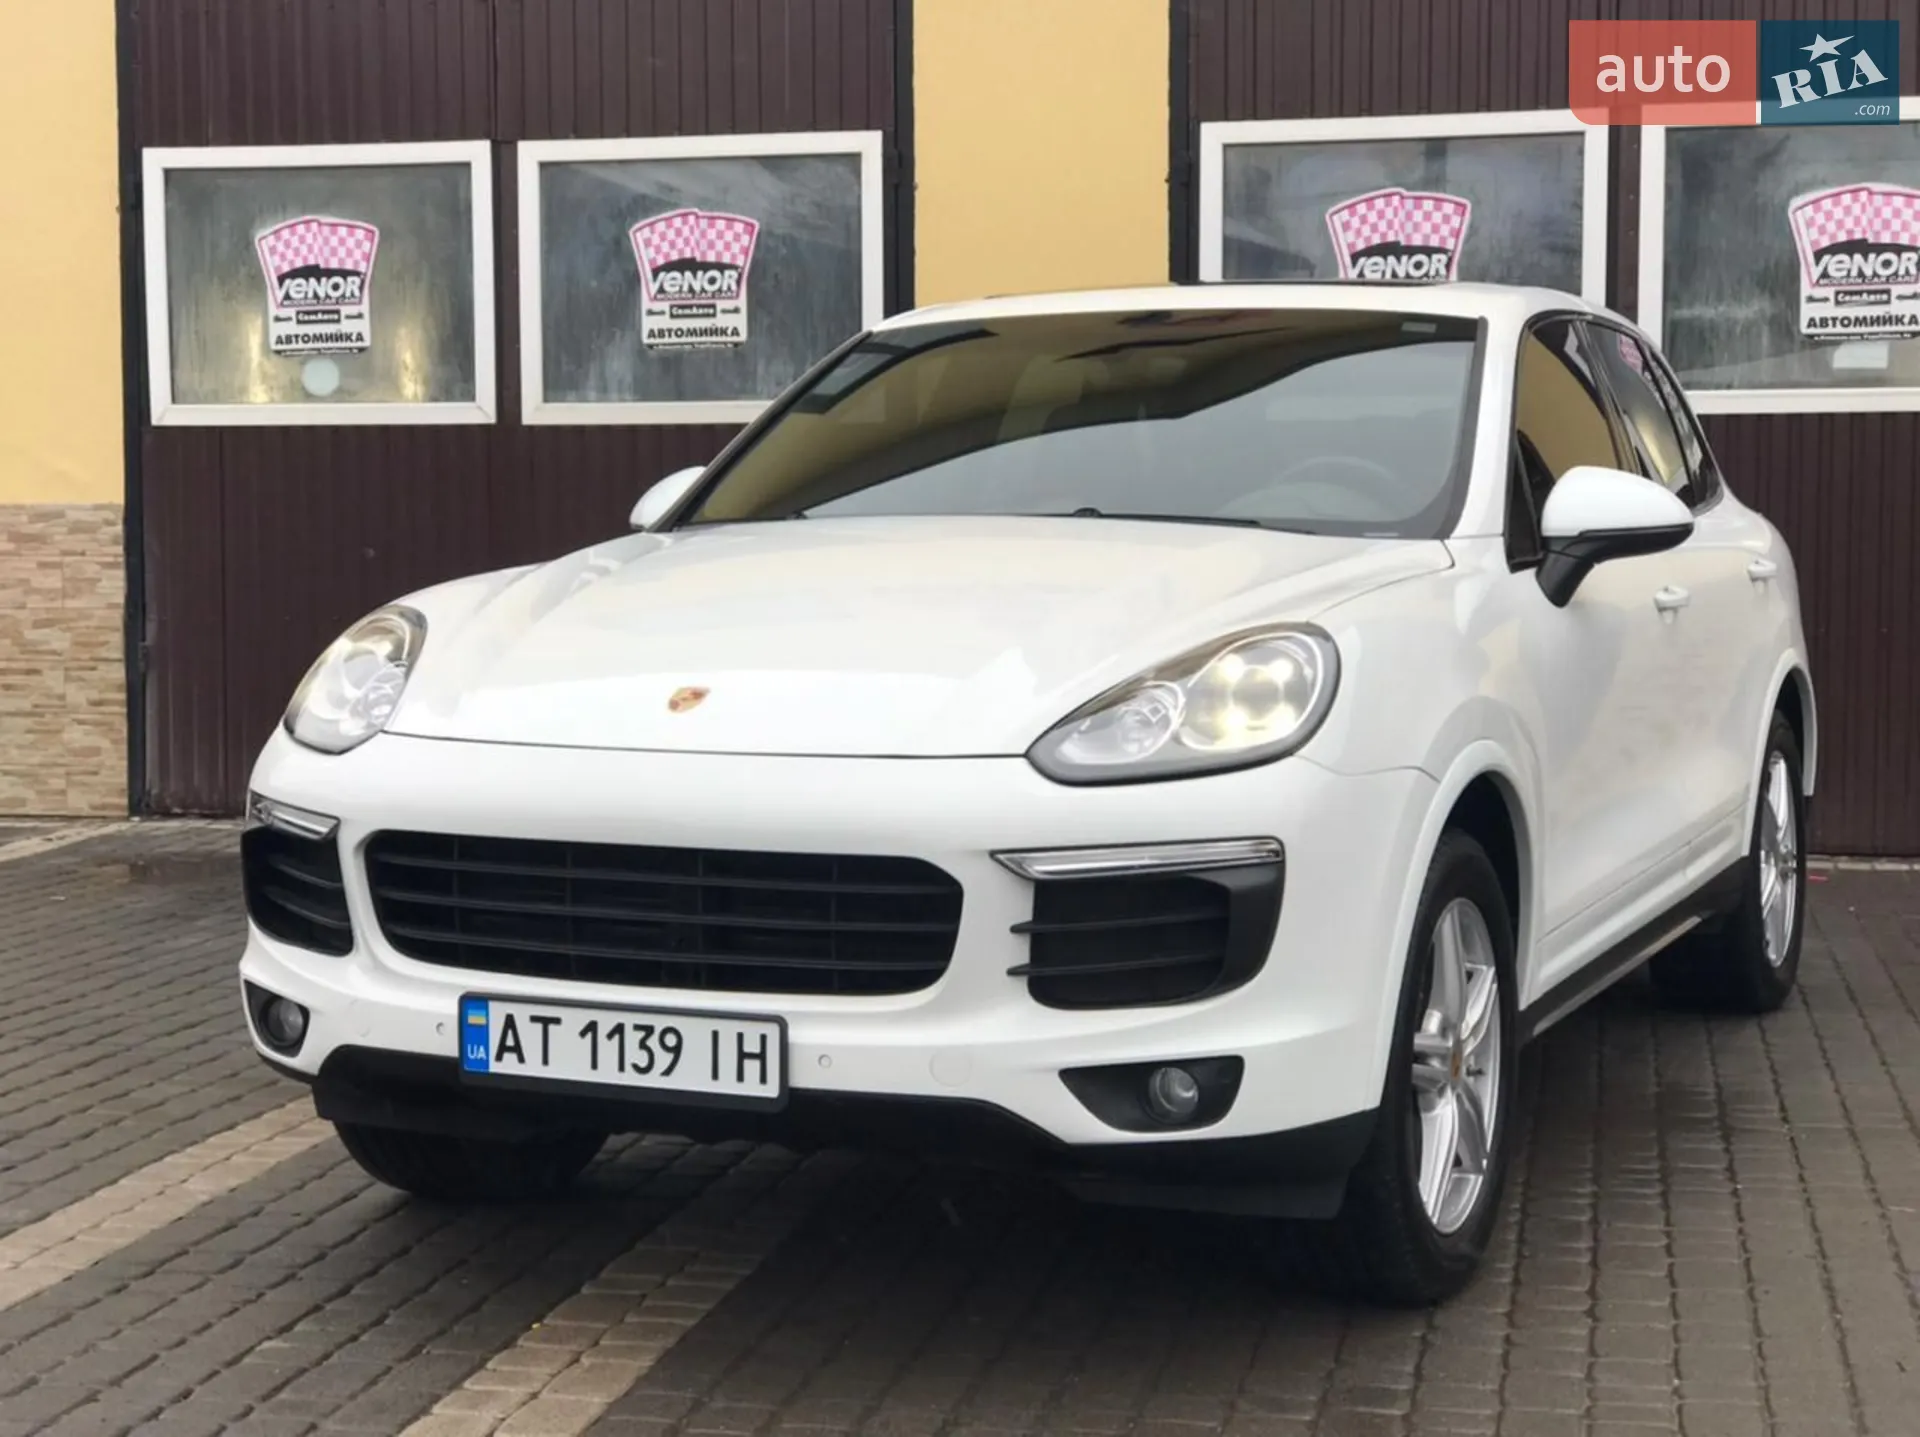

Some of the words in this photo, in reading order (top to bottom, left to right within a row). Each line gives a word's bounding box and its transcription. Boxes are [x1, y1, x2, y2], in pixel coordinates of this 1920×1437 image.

[1807, 312, 1919, 329] АВТОМИЙКА
[275, 330, 365, 346] АВТОМИЙКА
[647, 324, 741, 339] АВТОМИЙКА
[468, 1043, 487, 1060] UA
[494, 1013, 562, 1066] AT
[578, 1019, 683, 1077] 1139
[711, 1029, 767, 1085] IH
